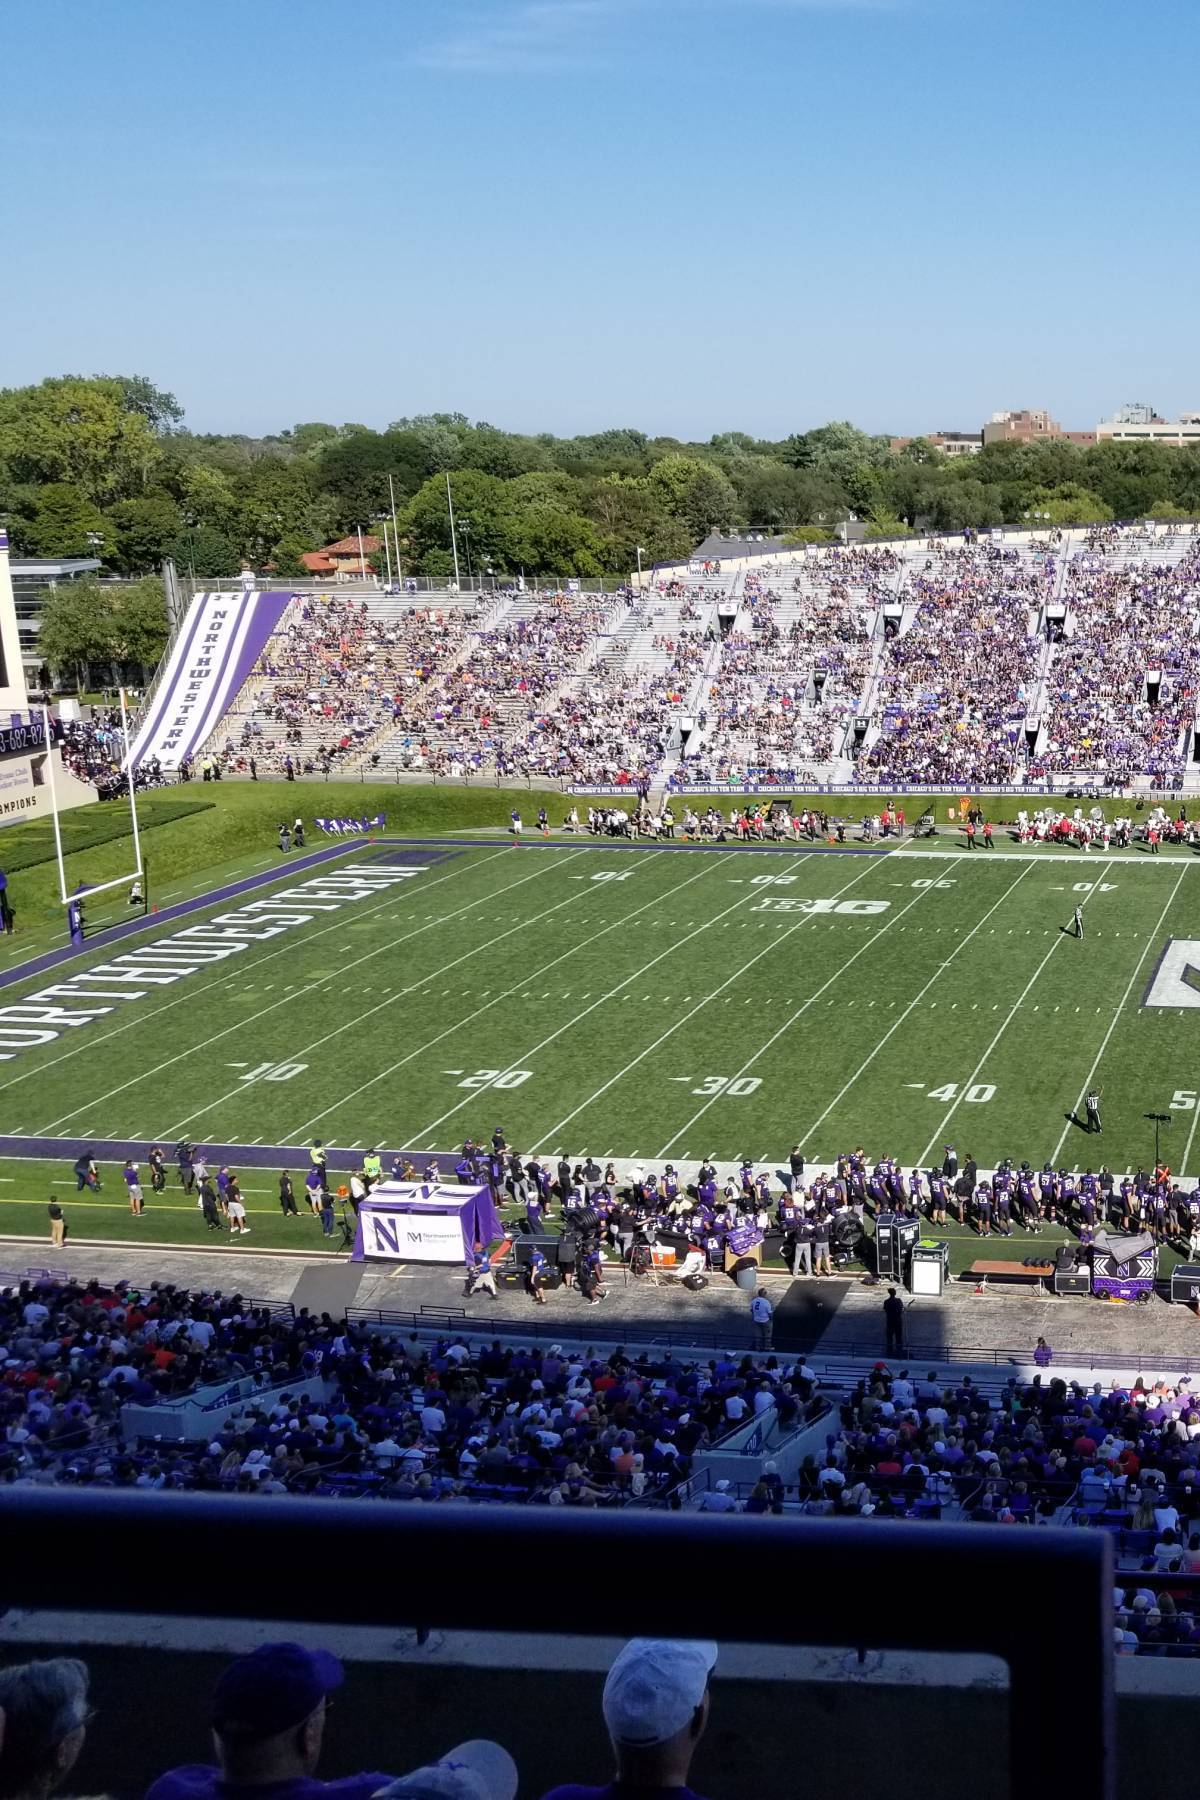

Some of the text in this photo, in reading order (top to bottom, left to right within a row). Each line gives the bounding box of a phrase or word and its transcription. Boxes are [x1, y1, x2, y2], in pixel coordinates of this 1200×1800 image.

[160, 609, 228, 751] NORTHWESTERN
[590, 872, 635, 880] 10
[750, 876, 799, 884] 20
[911, 879, 957, 887] 30
[1073, 882, 1119, 891] 40
[0, 864, 430, 1060] ORTHWESTERN
[238, 1062, 308, 1080] 10
[457, 1070, 533, 1088] 20
[692, 1077, 762, 1095] 30
[927, 1083, 997, 1102] 40
[567, 1199, 576, 1208] 15
[372, 1217, 400, 1252] N
